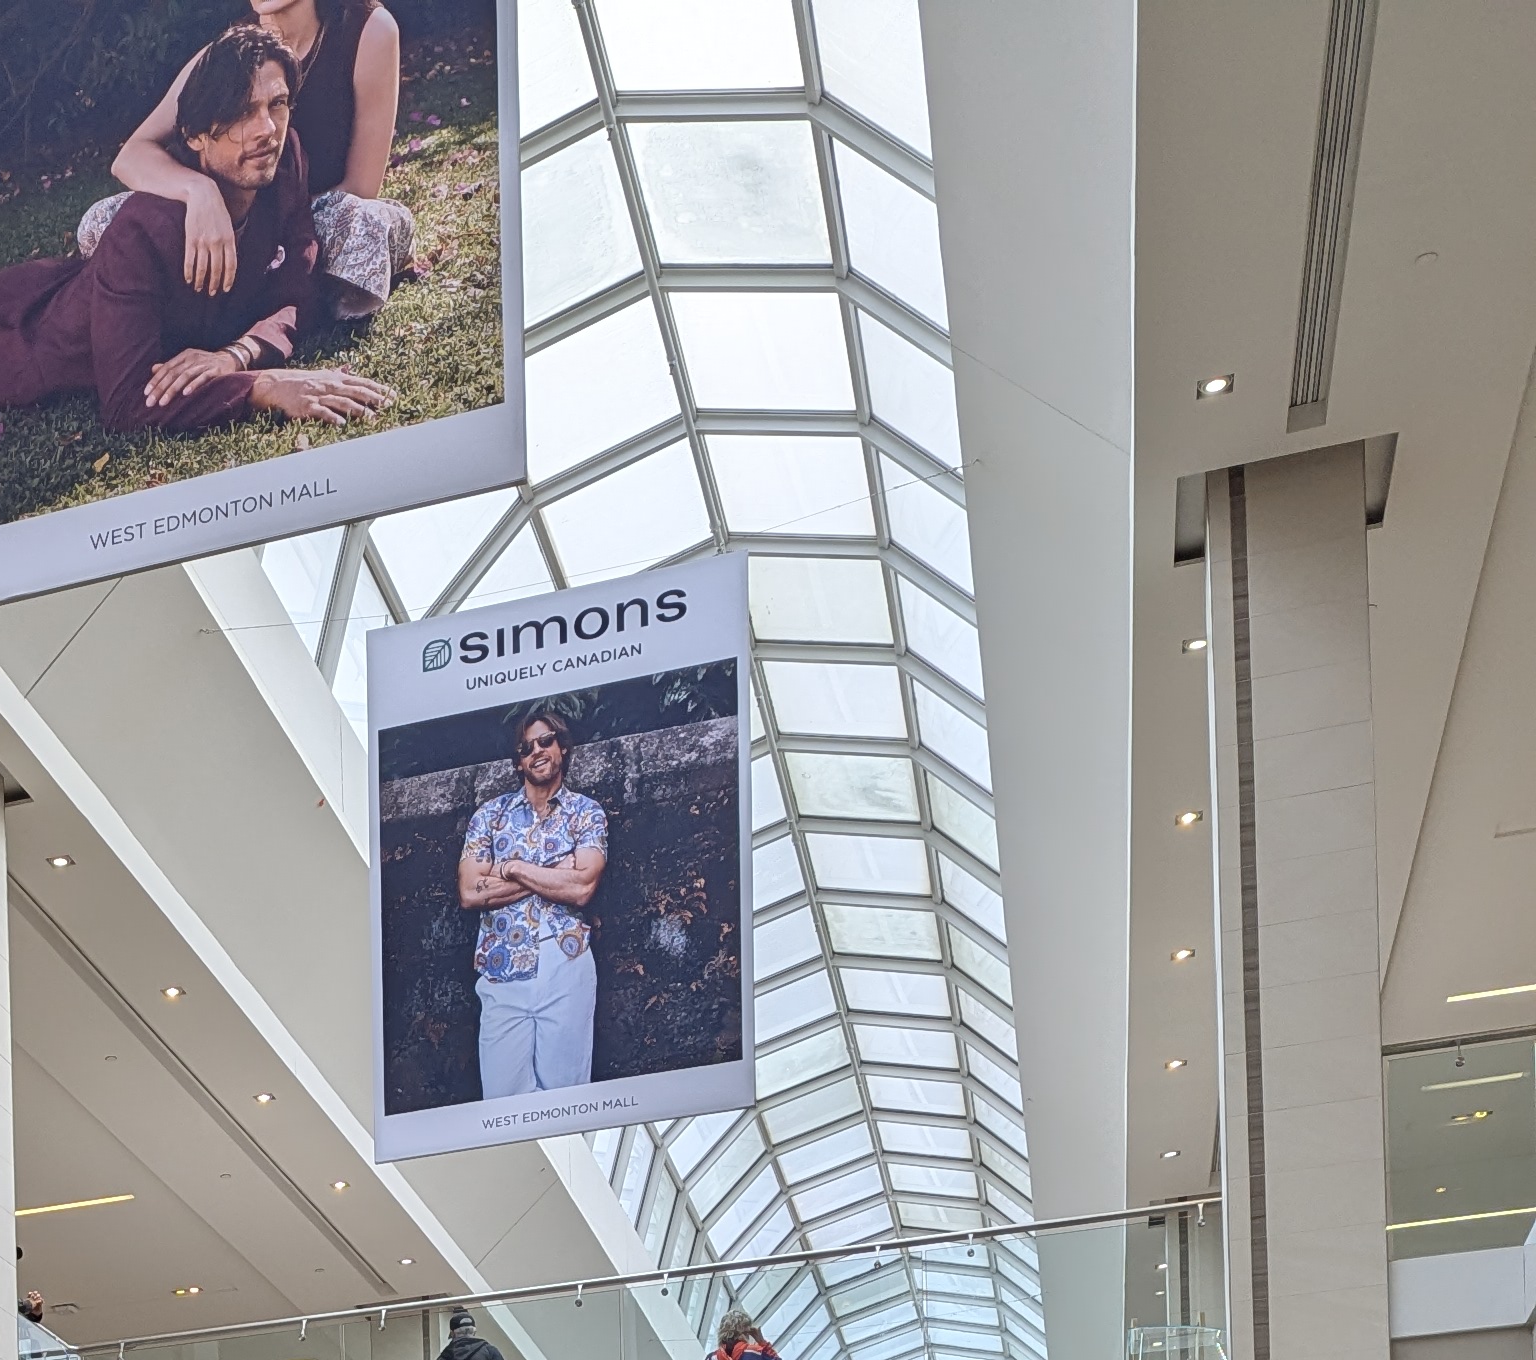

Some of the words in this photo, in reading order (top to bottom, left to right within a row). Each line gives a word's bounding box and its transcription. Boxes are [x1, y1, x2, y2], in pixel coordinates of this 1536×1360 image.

[90, 522, 147, 550] WEST
[154, 492, 273, 536] EDMONTON
[280, 478, 338, 506] MALL
[459, 589, 688, 664] simons
[466, 663, 547, 690] UNIQUELY
[552, 643, 642, 673] CANADIAN
[482, 1114, 519, 1129] WEST
[523, 1102, 599, 1123] EDMONTON
[603, 1096, 639, 1111] MALL
